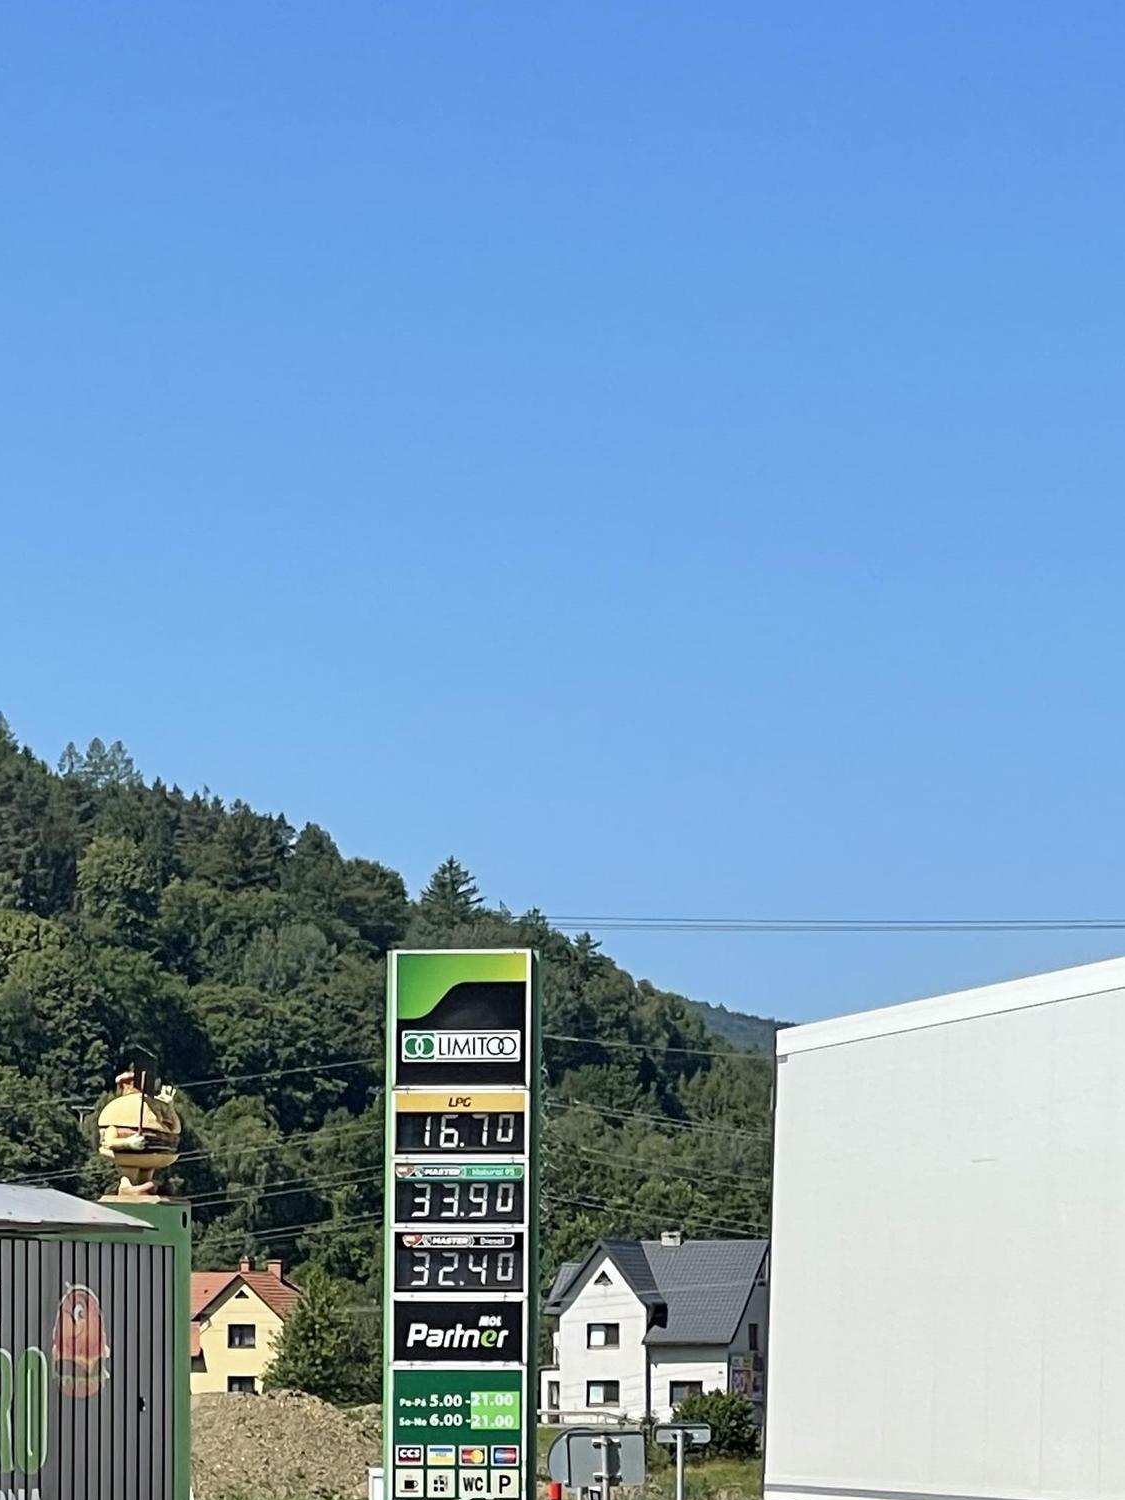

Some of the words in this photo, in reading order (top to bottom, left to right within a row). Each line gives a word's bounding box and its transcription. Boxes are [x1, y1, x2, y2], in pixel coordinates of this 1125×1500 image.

[448, 1097, 472, 1108] LPG
[424, 1114, 515, 1149] 16.70
[411, 1183, 515, 1217] 33.90
[432, 1237, 469, 1245] MASTER
[411, 1252, 514, 1286] 32.40
[407, 1323, 509, 1347] Partner
[429, 1395, 463, 1407] 5.00
[429, 1414, 463, 1426] 6.00
[400, 1449, 420, 1458] CCS
[463, 1477, 484, 1492] WC
[499, 1475, 511, 1494] P
